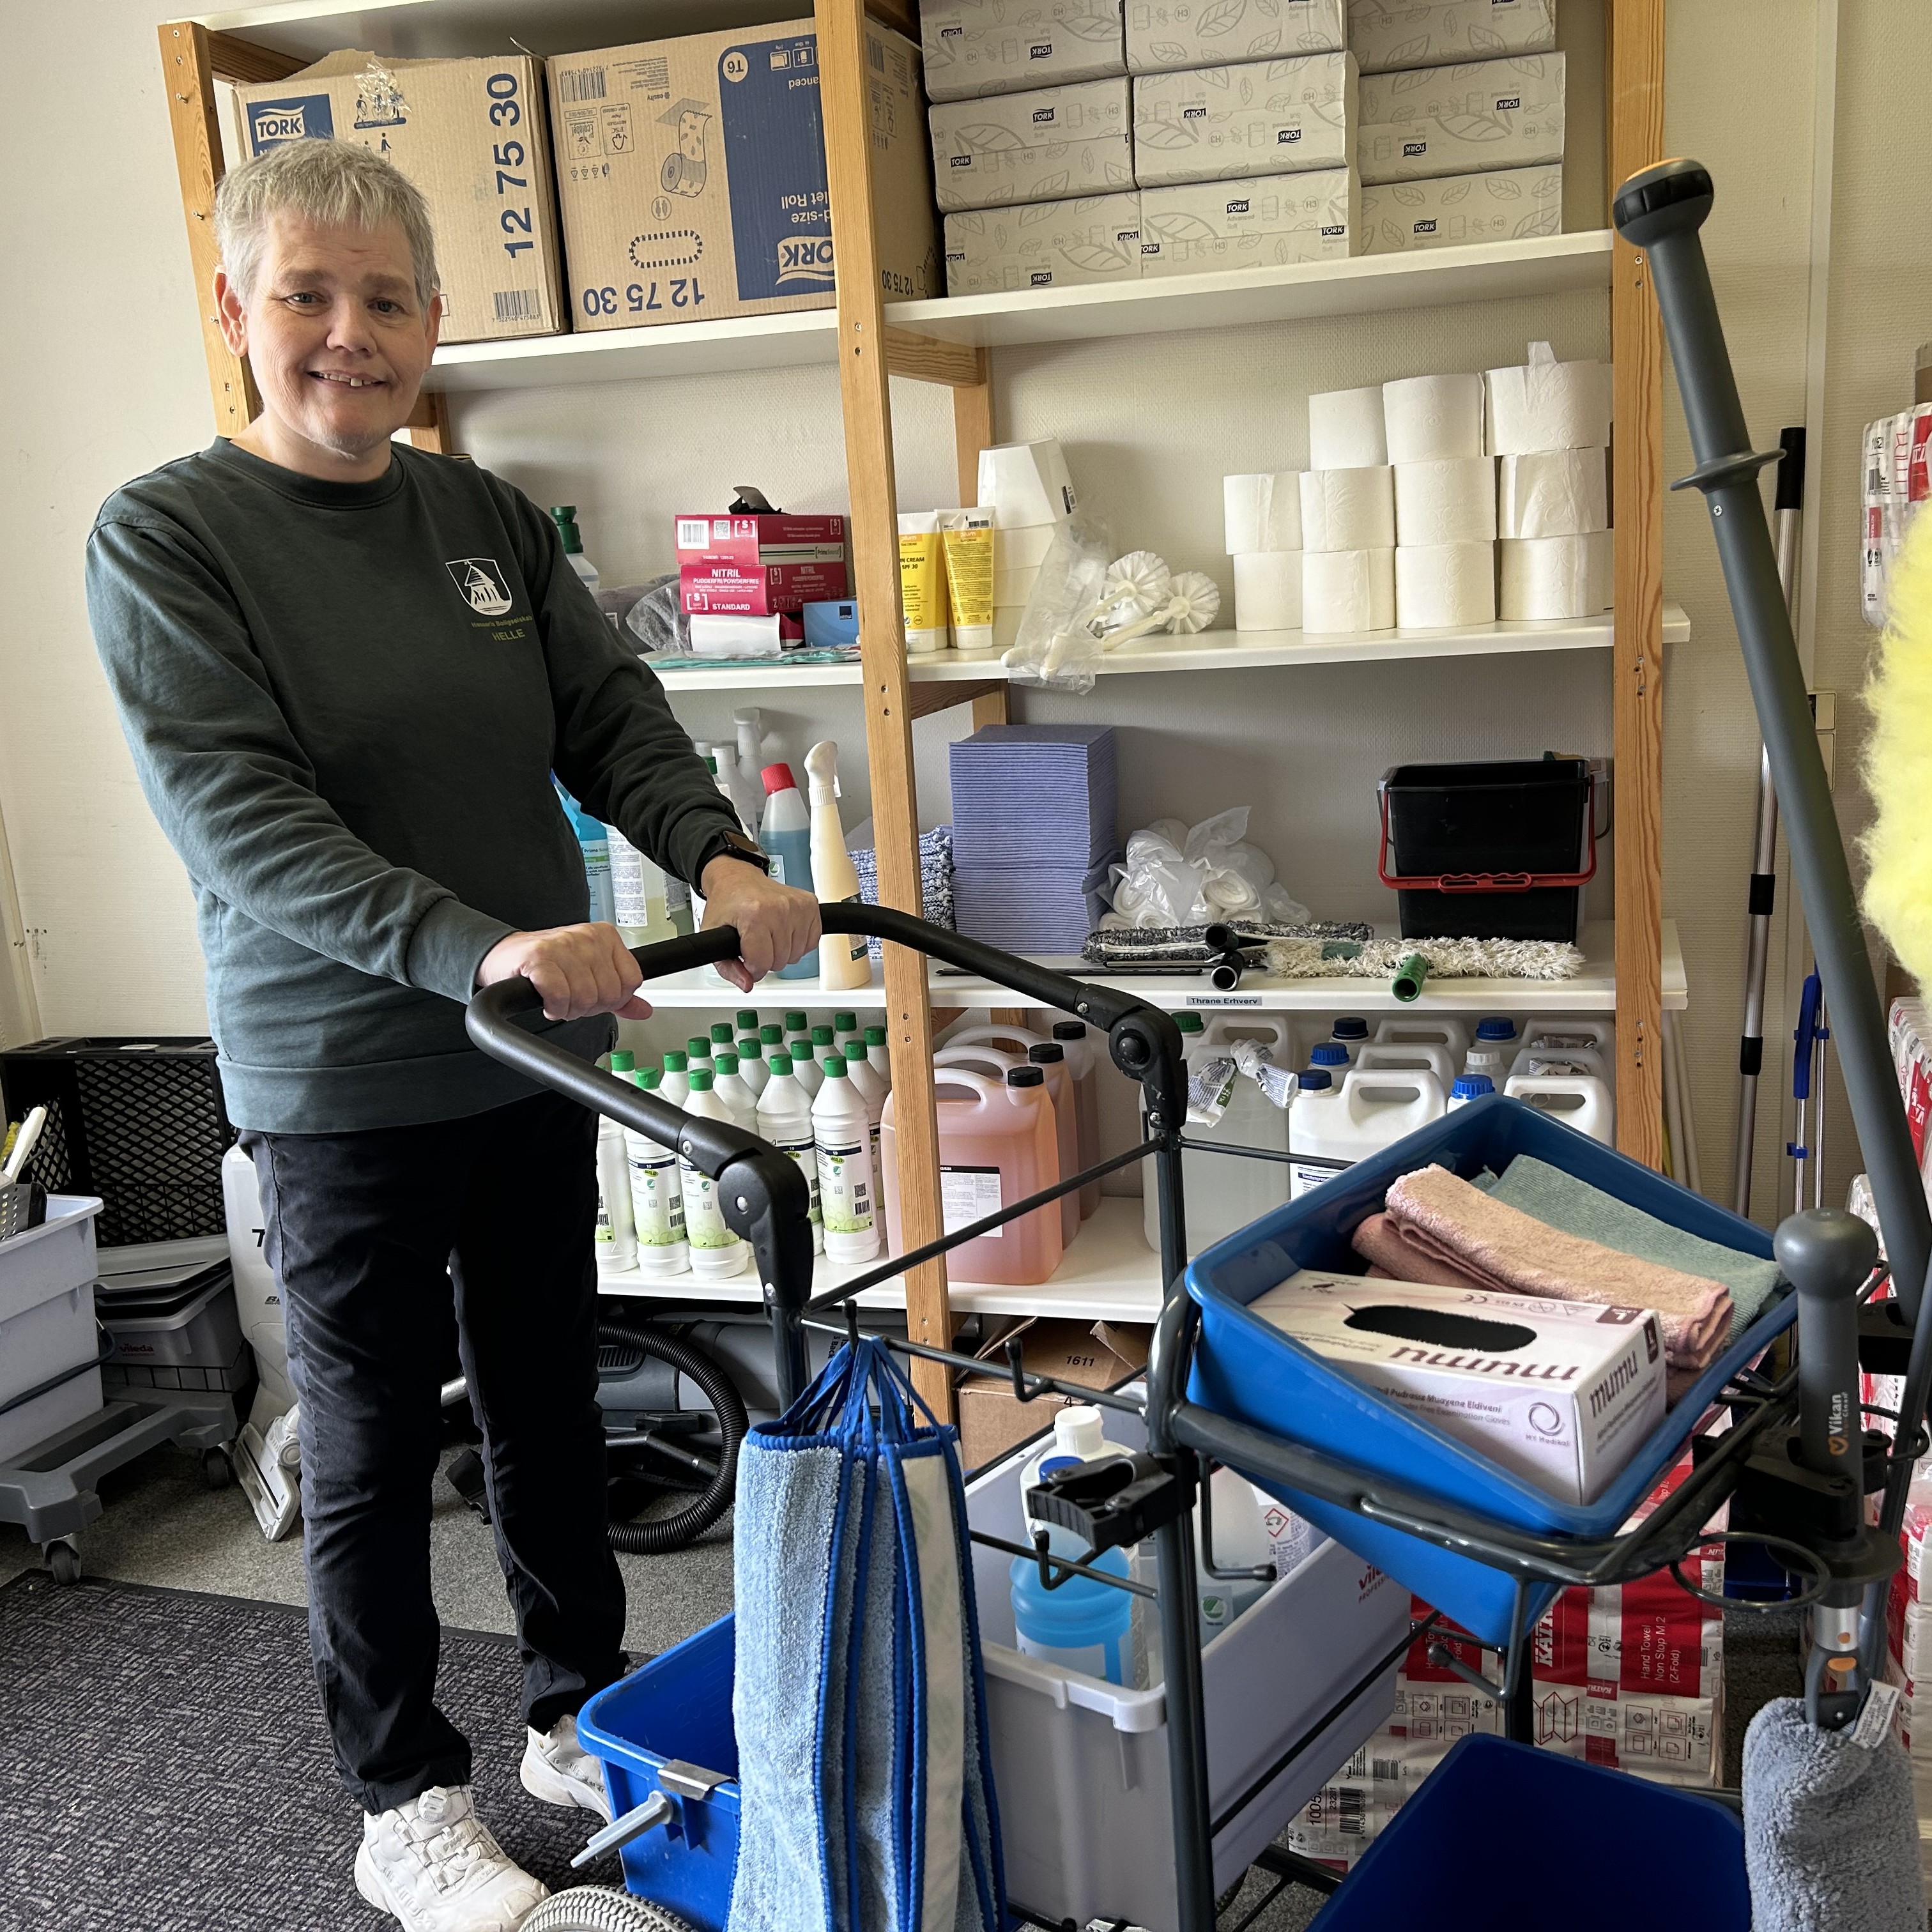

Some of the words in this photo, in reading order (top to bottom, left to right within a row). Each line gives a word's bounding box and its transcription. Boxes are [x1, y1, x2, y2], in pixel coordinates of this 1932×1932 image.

[1054, 8, 1064, 16] H3
[942, 28, 962, 38] TORK
[1032, 45, 1051, 55] TORK
[727, 60, 744, 73] T6
[788, 76, 819, 90] anced
[486, 72, 521, 128] 30
[1498, 99, 1519, 109] TORK
[1108, 107, 1119, 115] H3
[1428, 103, 1439, 112] H3
[1034, 112, 1052, 123] TORK
[1184, 109, 1206, 118] TORK
[257, 116, 302, 140] TORK
[934, 131, 944, 139] H3
[1280, 130, 1301, 140] TORK
[1404, 144, 1426, 153] TORK
[951, 157, 970, 165] TORK
[1023, 151, 1034, 160] H3
[493, 142, 527, 195] 75
[781, 194, 808, 210] Roll
[811, 191, 829, 205] let
[1227, 203, 1249, 213] TORK
[1306, 200, 1317, 208] H3
[791, 209, 831, 225] d-size
[1227, 213, 1255, 222] Advanced
[1414, 222, 1436, 233] TORK
[1493, 219, 1504, 227] H3
[503, 206, 534, 259] 12
[1118, 231, 1138, 241] TORK
[1322, 226, 1344, 236] TORK
[1215, 241, 1225, 250] H3
[782, 240, 834, 268] ORK
[946, 253, 965, 262] TORK
[882, 269, 892, 289] 30
[894, 273, 903, 293] 75
[969, 277, 979, 285] H3
[1032, 273, 1052, 282] TORK
[904, 276, 914, 296] 12
[625, 281, 663, 312] 75
[669, 277, 705, 307] 12
[582, 285, 617, 317] 30
[741, 519, 749, 529] S
[711, 568, 741, 578] NITRIL
[693, 592, 701, 601] S
[492, 628, 525, 641] HELLE
[119, 1343, 155, 1353] vileda
[828, 1341, 839, 1359] Back
[1066, 1355, 1095, 1367] 1611
[1388, 1346, 1579, 1381] mumu
[1589, 1350, 1639, 1419] mumu
[1063, 1396, 1073, 1407] 4
[1467, 1400, 1502, 1413] Eldiveni
[1438, 1408, 1485, 1422] Examination
[1485, 1414, 1510, 1425] Gloves
[1828, 1393, 1843, 1435] Vikan
[1539, 1436, 1570, 1446] Medikal
[1358, 1564, 1382, 1590] vil
[1655, 1616, 1666, 1624] 2
[1655, 1625, 1666, 1636] M
[1640, 1624, 1652, 1653] Towel
[1655, 1639, 1668, 1662] Stop
[1640, 1655, 1650, 1680] Hand
[1669, 1648, 1682, 1684] (Z-Fold)
[1655, 1664, 1664, 1682] Non
[1588, 1683, 1613, 1694] KATRI
